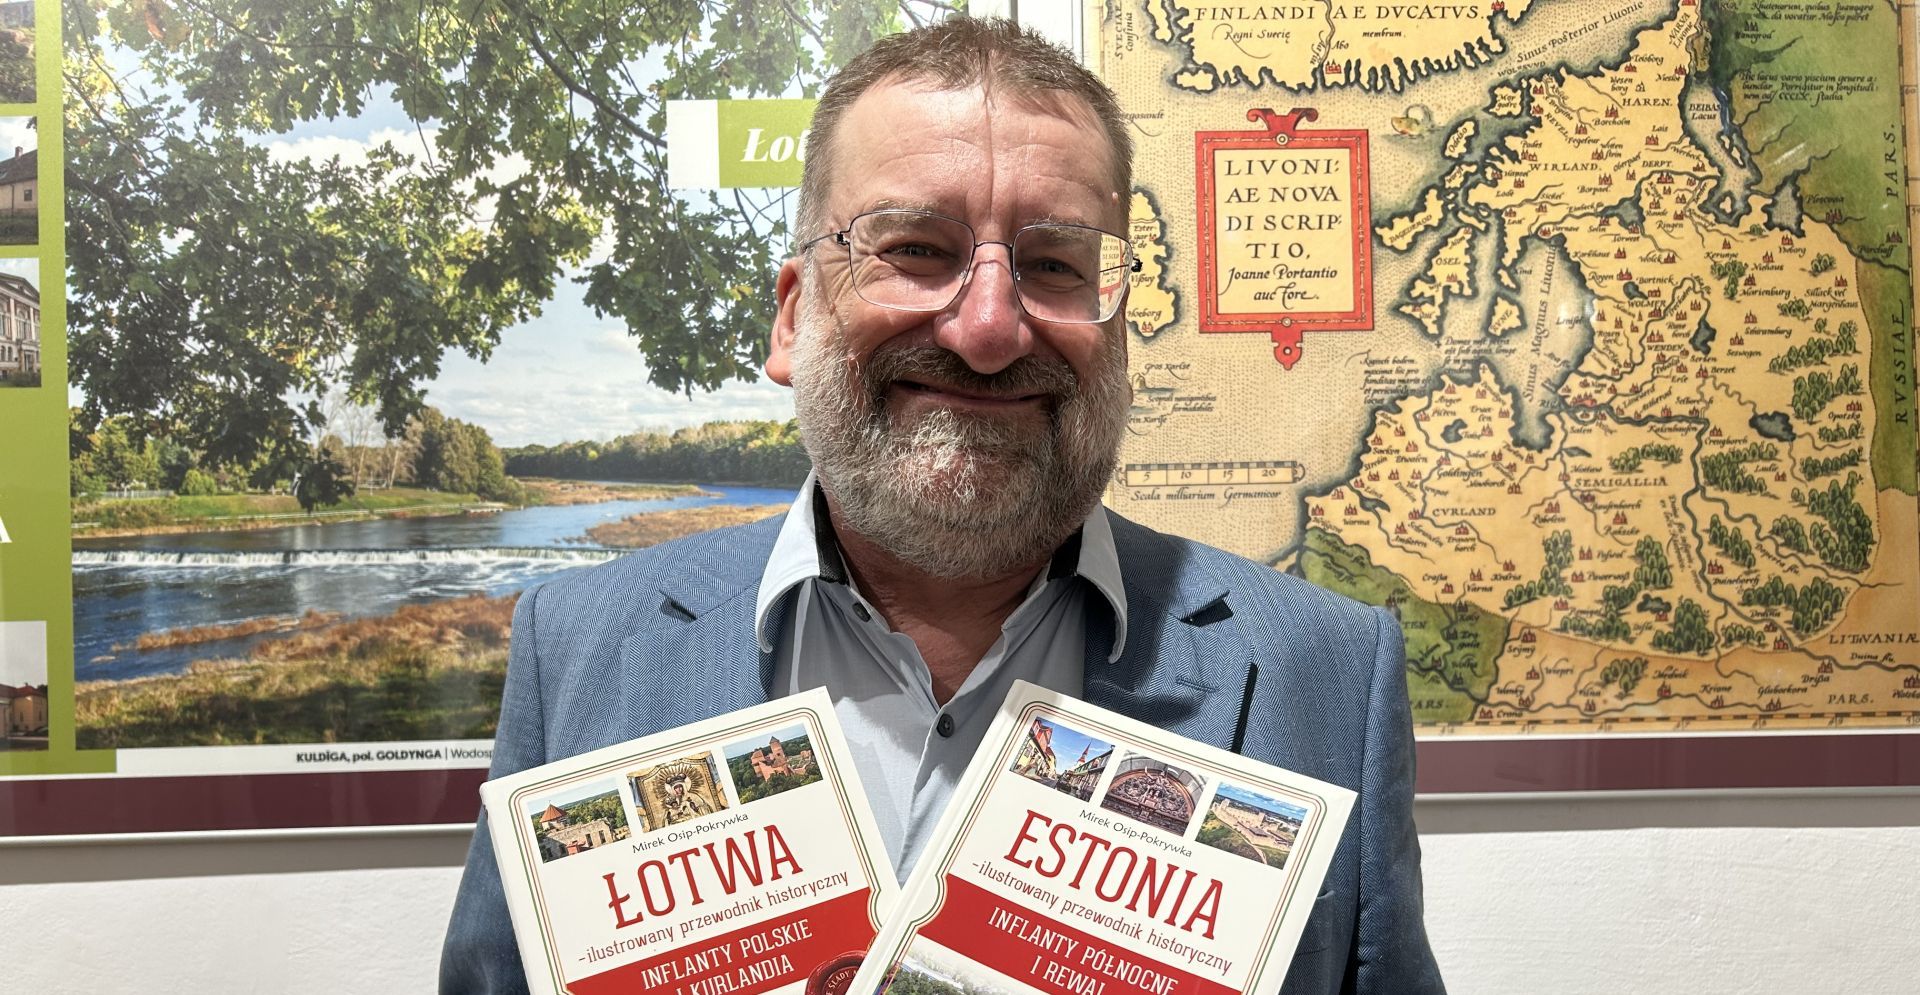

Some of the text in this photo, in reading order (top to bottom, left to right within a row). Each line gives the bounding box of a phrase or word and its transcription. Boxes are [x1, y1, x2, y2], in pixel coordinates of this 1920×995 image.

[1194, 6, 1315, 22] FINLANDI
[1334, 6, 1368, 20] AE
[1516, 43, 1549, 65] Sinus
[1549, 20, 1602, 48] Posterior
[1224, 185, 1342, 204] AE NOVA
[1225, 215, 1255, 232] DI
[1270, 262, 1339, 281] Portantio
[1130, 488, 1162, 502] Scala
[1180, 470, 1192, 480] 10
[1222, 469, 1235, 482] 15
[1261, 468, 1277, 478] 20
[352, 750, 375, 764] pol.
[376, 749, 442, 761] GOLDYNGA
[631, 810, 750, 855] Mirek Osip-Pokrywka
[1078, 808, 1194, 859] Mirek Osip-Pokrywka
[601, 822, 805, 931] ŁOTWA
[1003, 808, 1225, 942] ESTONIA
[679, 896, 764, 940] przewodnik
[766, 870, 850, 908] historyczny
[640, 916, 814, 991] INFLANTY POLSKIE
[986, 905, 1081, 960] INFLANTY
[1060, 898, 1144, 942] przewodnik
[1147, 927, 1234, 978] historyczny
[1030, 954, 1042, 976] I
